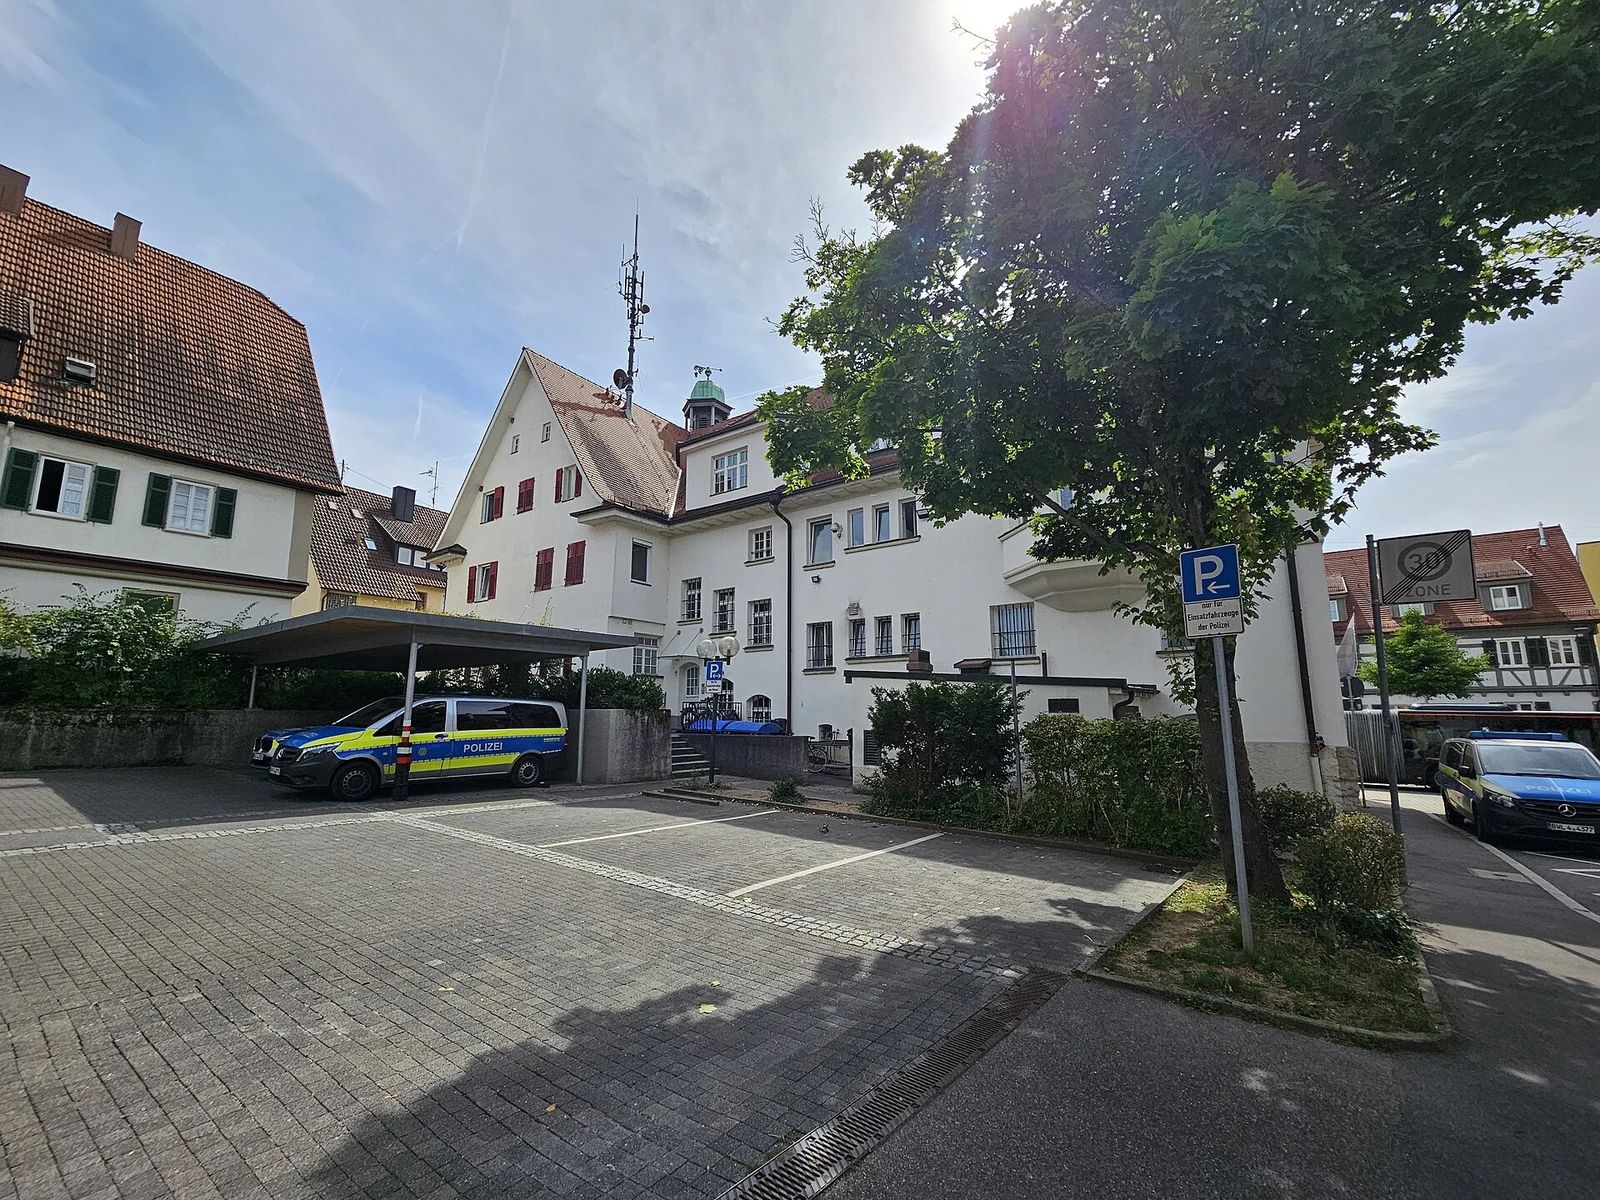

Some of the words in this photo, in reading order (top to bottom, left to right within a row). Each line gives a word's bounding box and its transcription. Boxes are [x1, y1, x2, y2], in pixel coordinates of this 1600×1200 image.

[1193, 555, 1224, 595] P
[1405, 584, 1451, 598] ZONE
[1188, 611, 1239, 621] Einsatzfahrzeuge
[1209, 621, 1230, 630] Polizei
[710, 664, 719, 678] P
[463, 742, 503, 753] POLIZEI
[1525, 785, 1592, 794] POLIZEI
